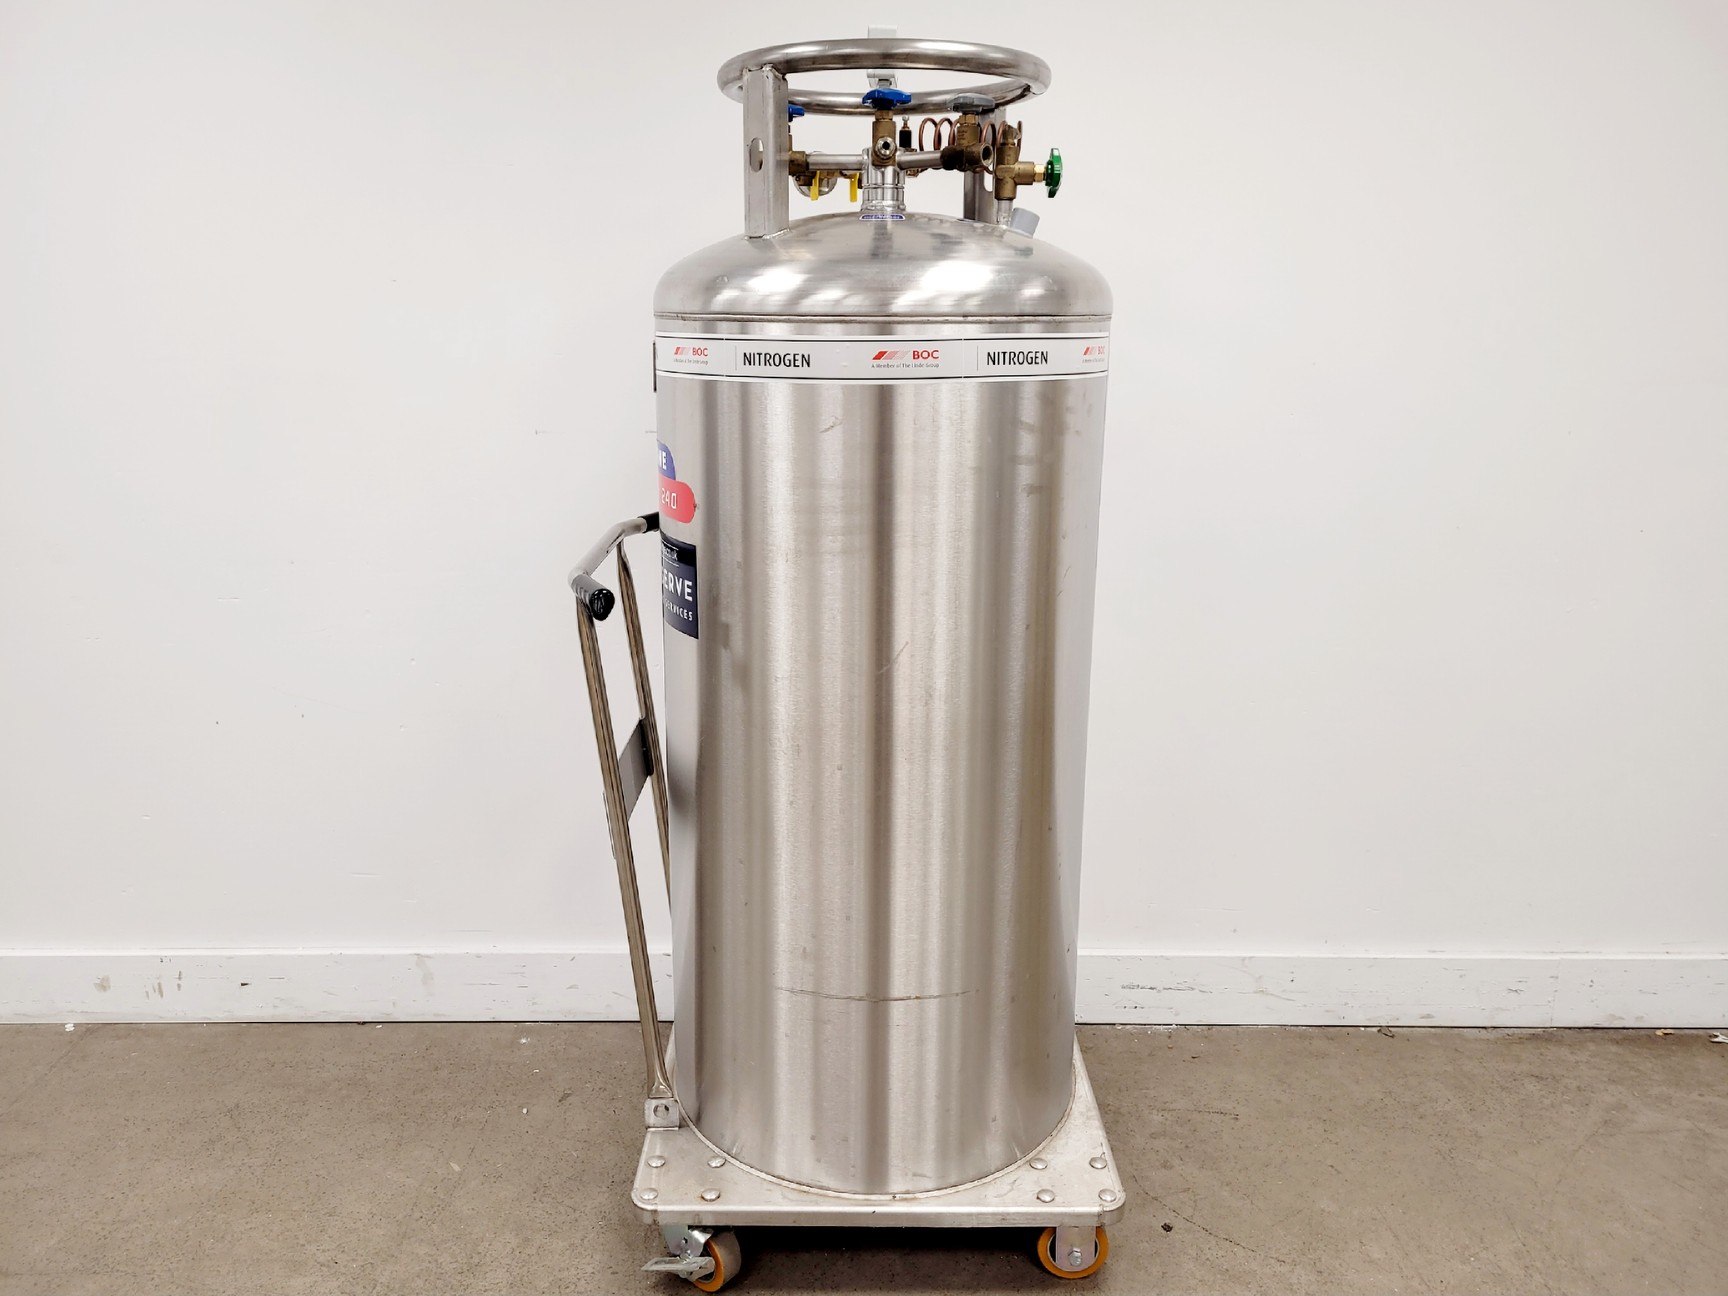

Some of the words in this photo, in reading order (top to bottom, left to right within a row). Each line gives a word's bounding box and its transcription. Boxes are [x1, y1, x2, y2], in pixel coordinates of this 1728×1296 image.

[692, 347, 708, 357] BOC
[912, 350, 940, 360] BOC
[987, 351, 1049, 366] NITROGEN
[743, 352, 811, 368] NITROGEN
[662, 568, 693, 602] ERVE
